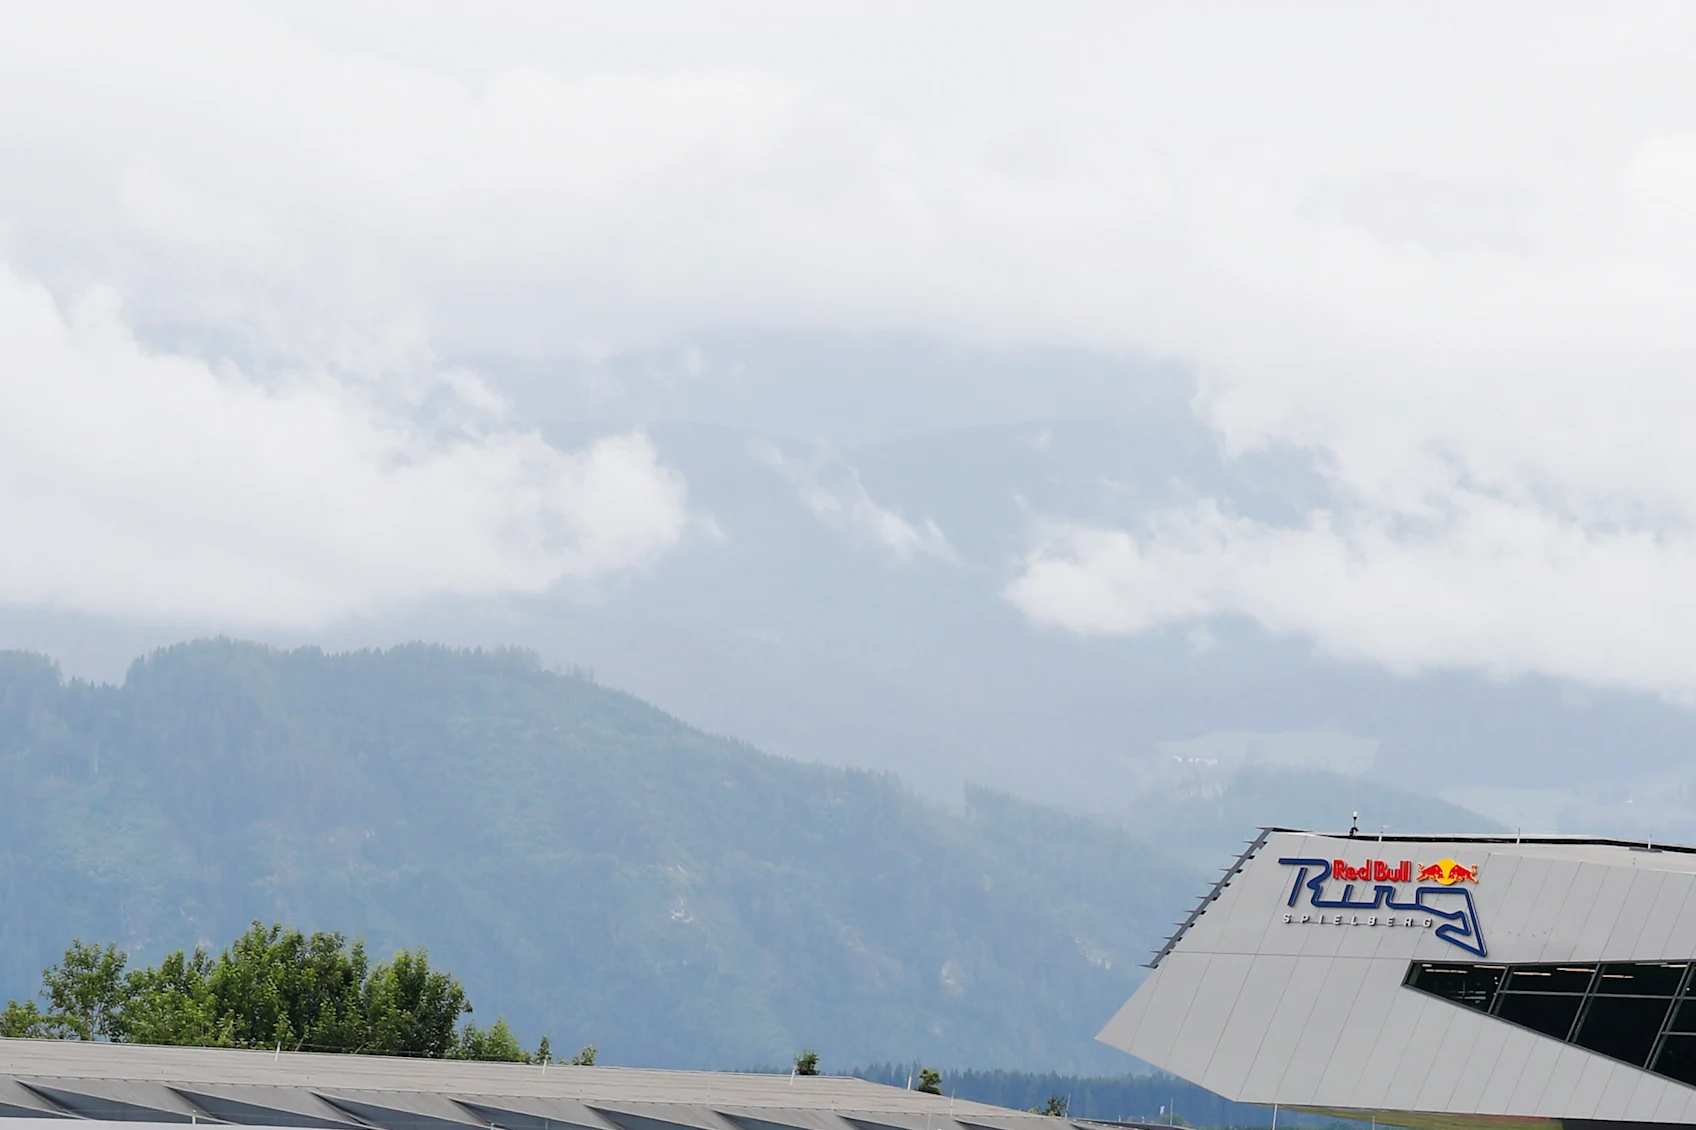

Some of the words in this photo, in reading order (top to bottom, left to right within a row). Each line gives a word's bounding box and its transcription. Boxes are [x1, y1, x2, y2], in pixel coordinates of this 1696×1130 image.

[1332, 859, 1371, 881] Red
[1373, 859, 1412, 882] Bull
[1281, 914, 1433, 928] SPIELBERG
